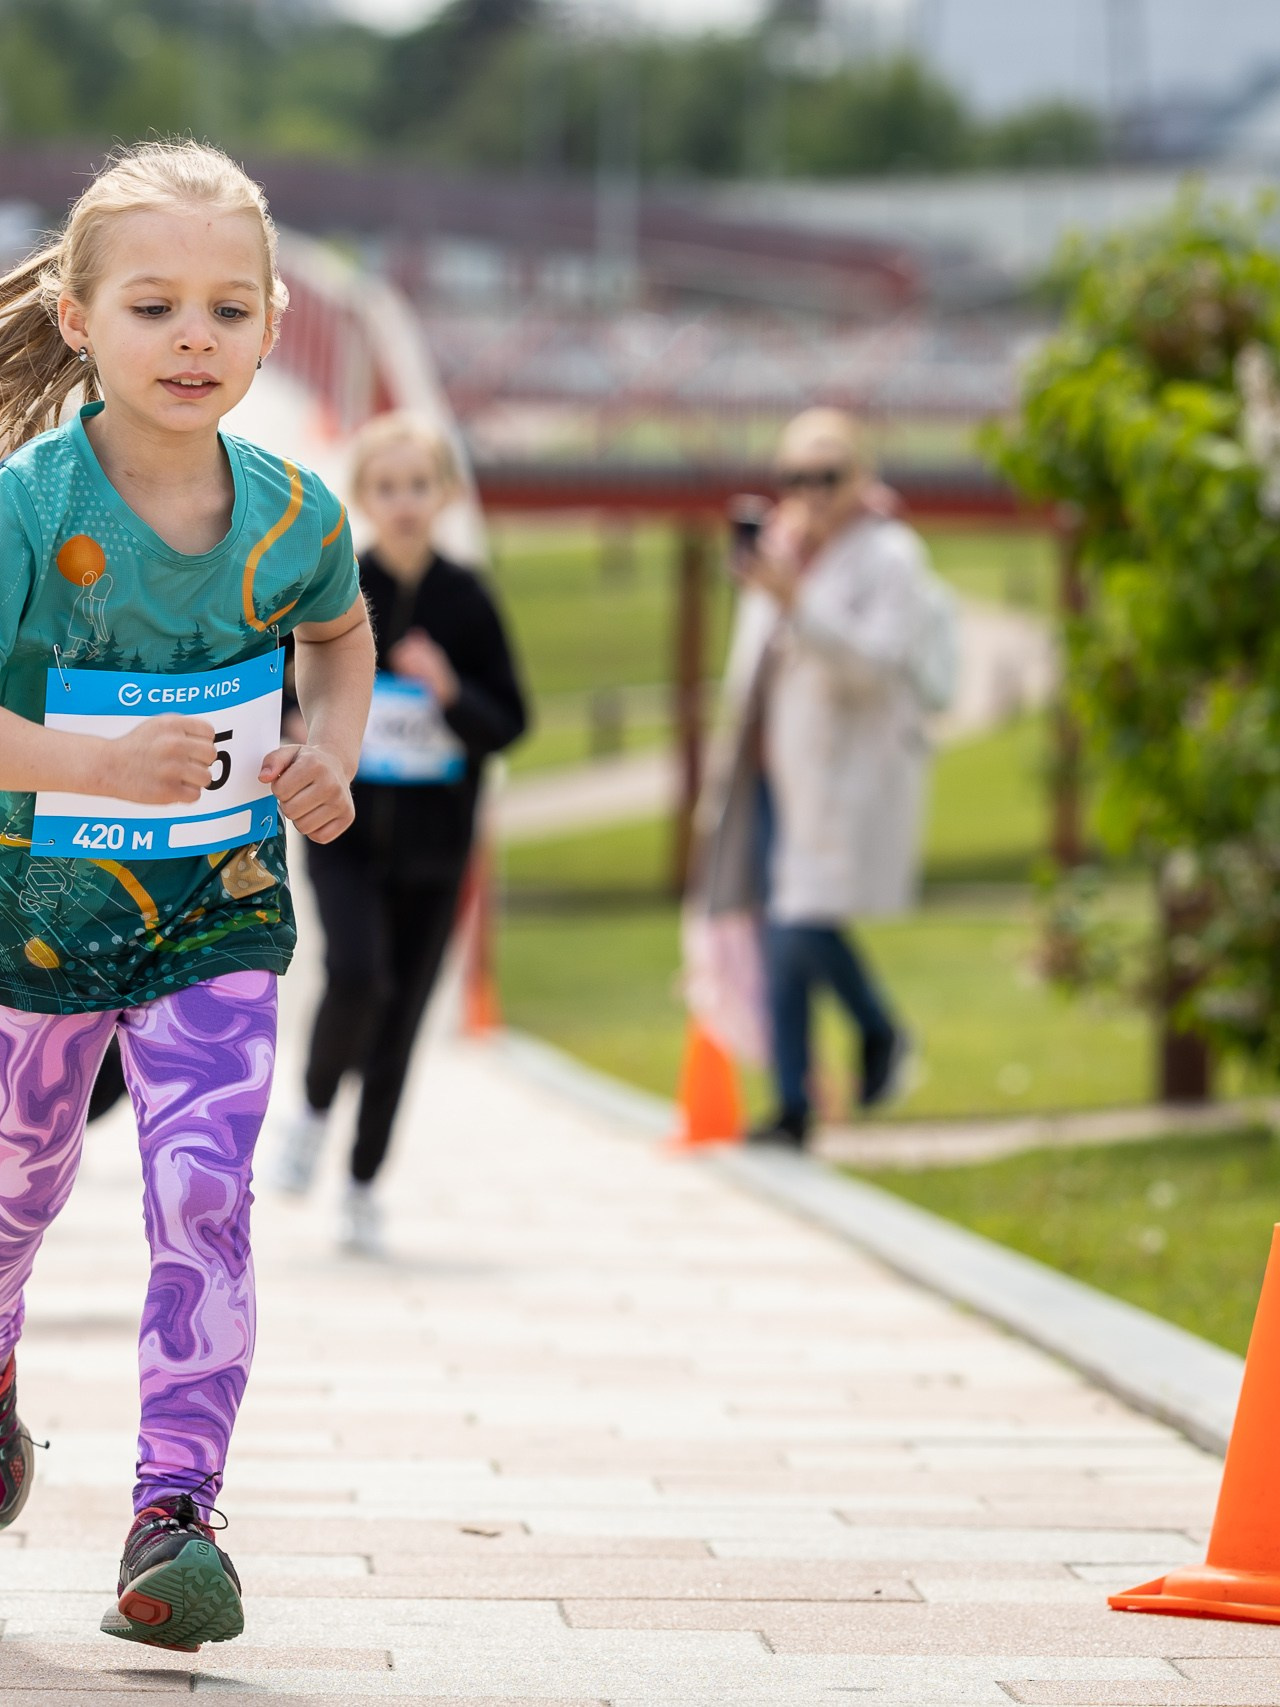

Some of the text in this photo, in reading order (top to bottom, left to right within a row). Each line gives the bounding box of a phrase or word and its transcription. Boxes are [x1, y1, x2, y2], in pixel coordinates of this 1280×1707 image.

[147, 677, 241, 703] СБЕР KIDS
[72, 822, 125, 850] 420
